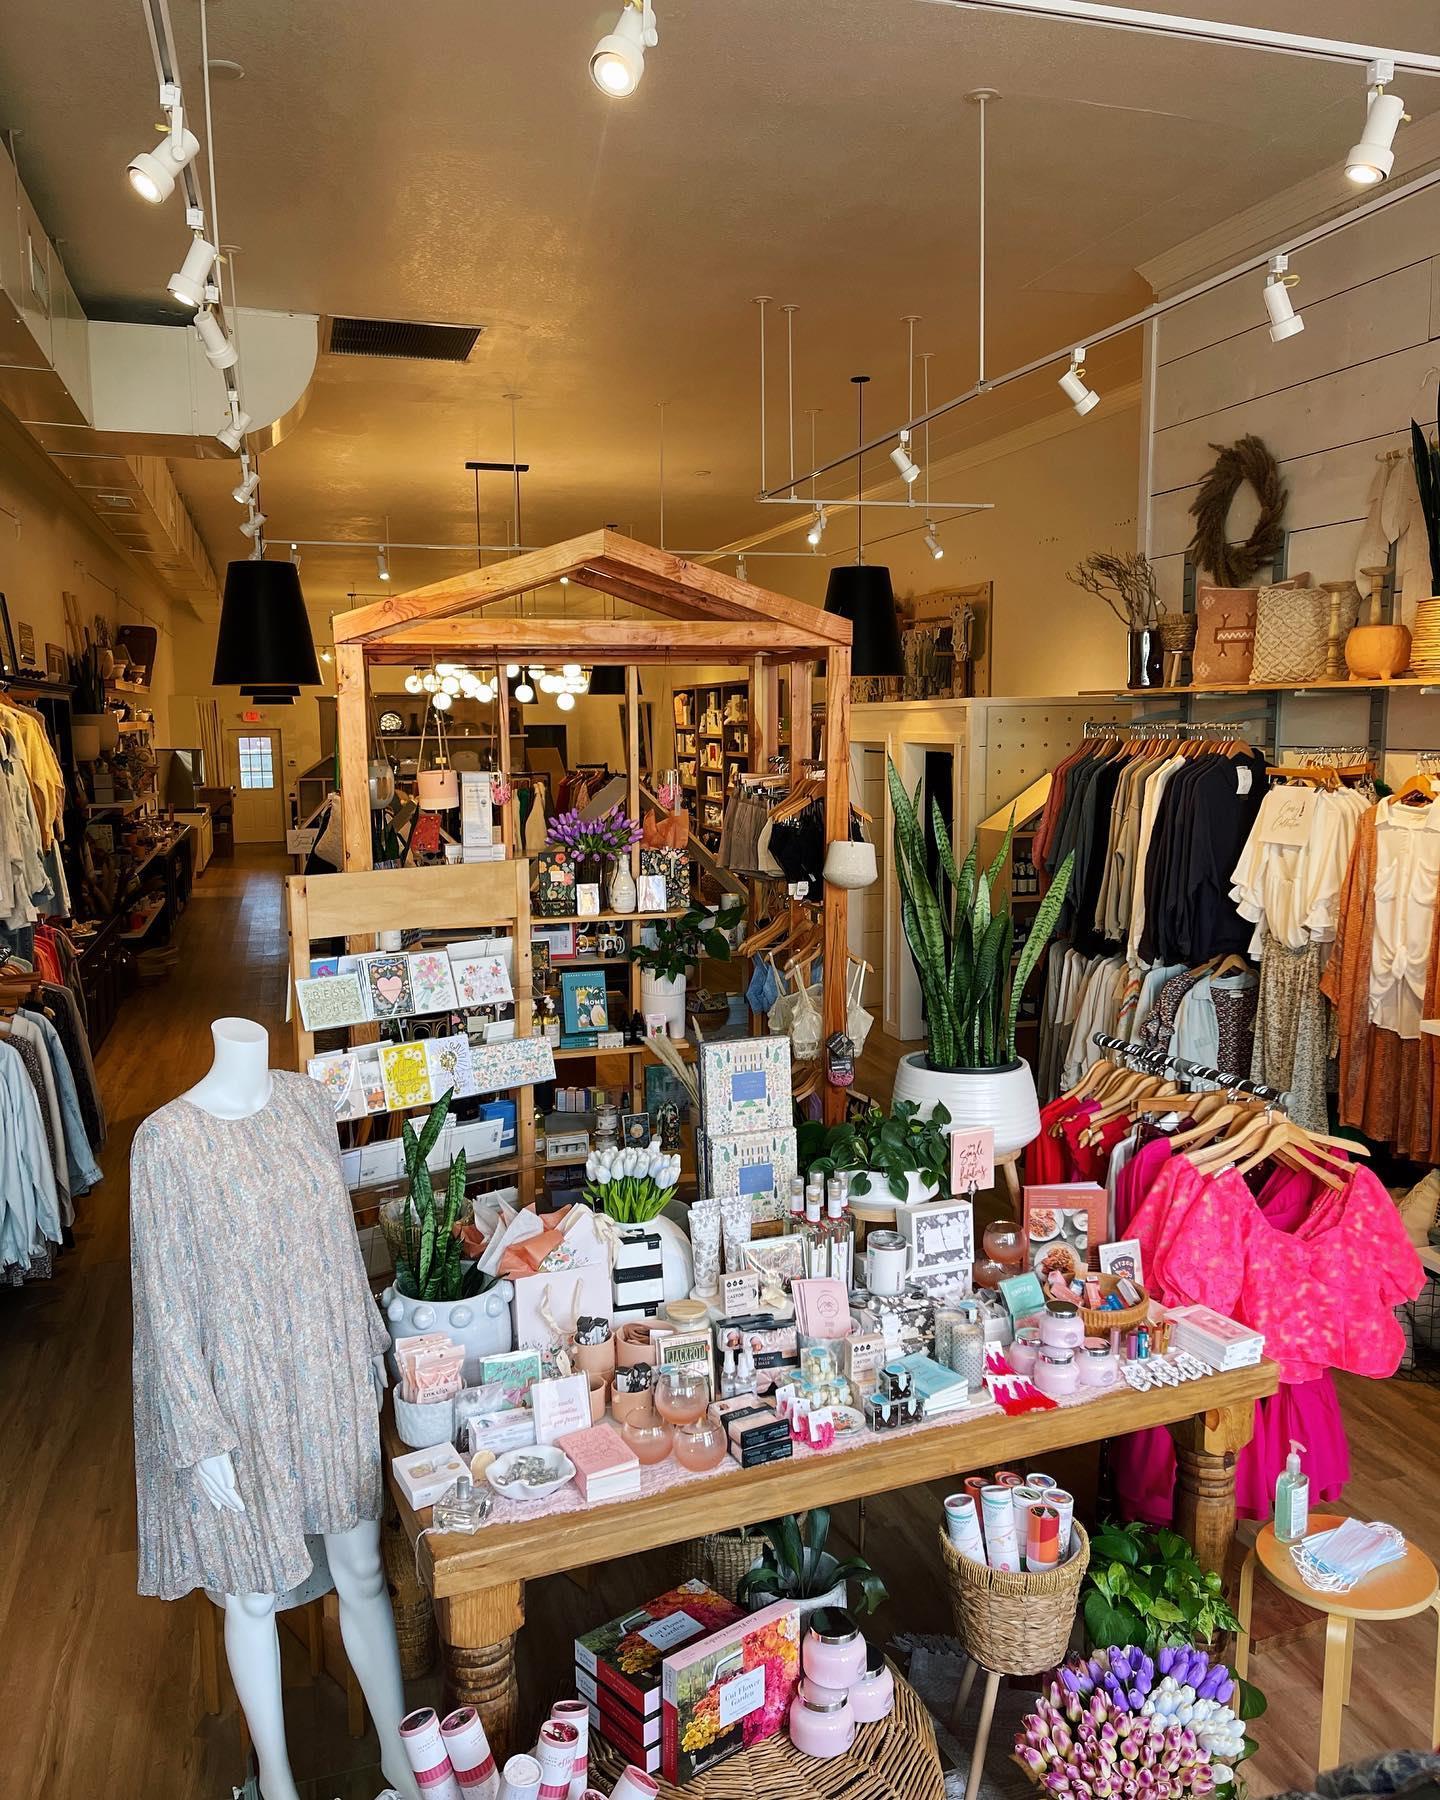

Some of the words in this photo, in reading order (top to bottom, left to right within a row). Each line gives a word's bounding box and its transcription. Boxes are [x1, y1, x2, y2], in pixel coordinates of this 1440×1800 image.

[312, 986, 350, 1000] BEST
[311, 1001, 359, 1016] WISHES
[737, 1679, 761, 1696] Flower
[730, 1691, 755, 1707] Garden
